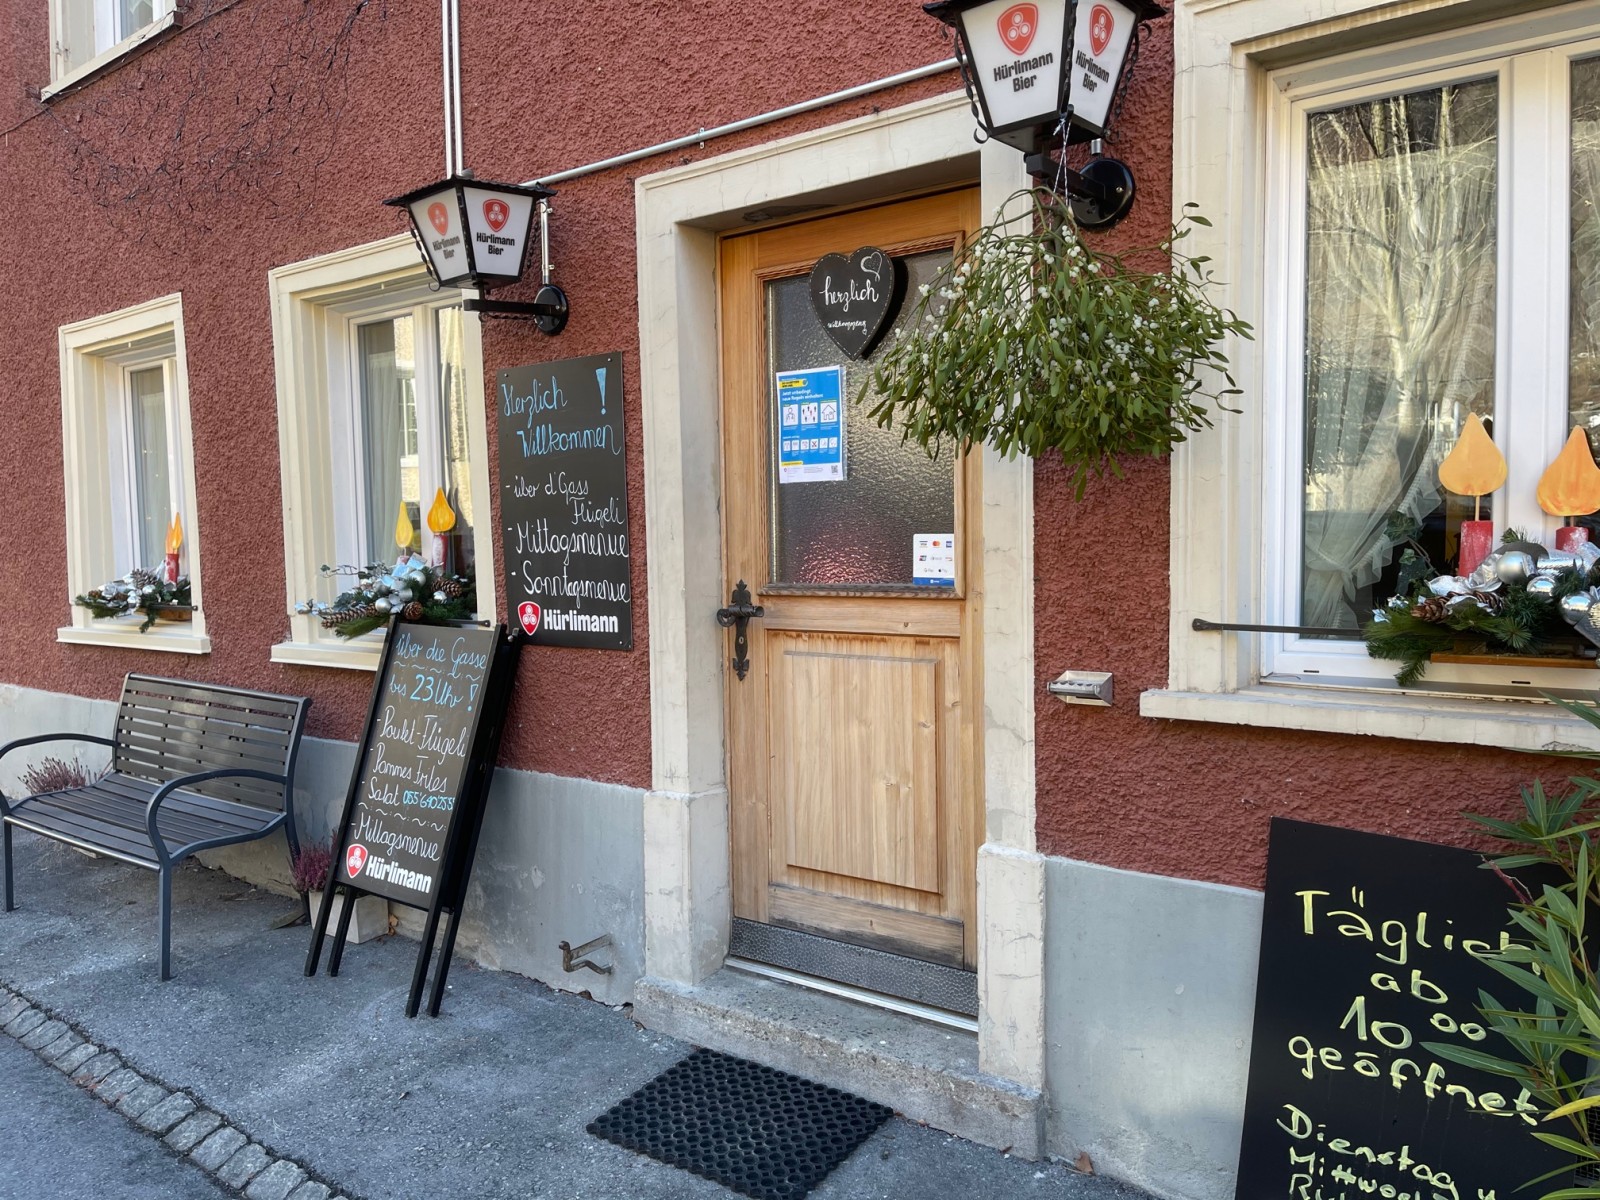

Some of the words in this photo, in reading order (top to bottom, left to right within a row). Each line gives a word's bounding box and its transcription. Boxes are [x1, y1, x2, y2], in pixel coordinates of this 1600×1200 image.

[993, 51, 1054, 82] Hürlimann
[1012, 73, 1037, 92] Bier
[1075, 50, 1110, 84] Hürlimann
[1082, 73, 1097, 93] Bier
[432, 235, 461, 251] Hürlimann
[443, 248, 455, 260] Bier
[476, 232, 515, 246] Hürlimann
[488, 245, 504, 256] Bier
[819, 275, 879, 312] herzlich
[501, 375, 568, 429] Herzlich
[516, 423, 621, 458] Willkommen
[569, 496, 625, 528] Flügeli
[543, 608, 619, 633] Hürlimann
[425, 637, 446, 663] die
[451, 636, 487, 679] Gasse
[389, 674, 407, 697] bis
[373, 741, 412, 780] Pommes
[413, 755, 448, 793] Frites
[368, 776, 401, 806] Salat
[365, 854, 433, 894] Hürlimann
[1370, 968, 1448, 1004] ab
[1288, 1036, 1540, 1126] geöffnet
[1276, 1103, 1460, 1200] Dienstag
